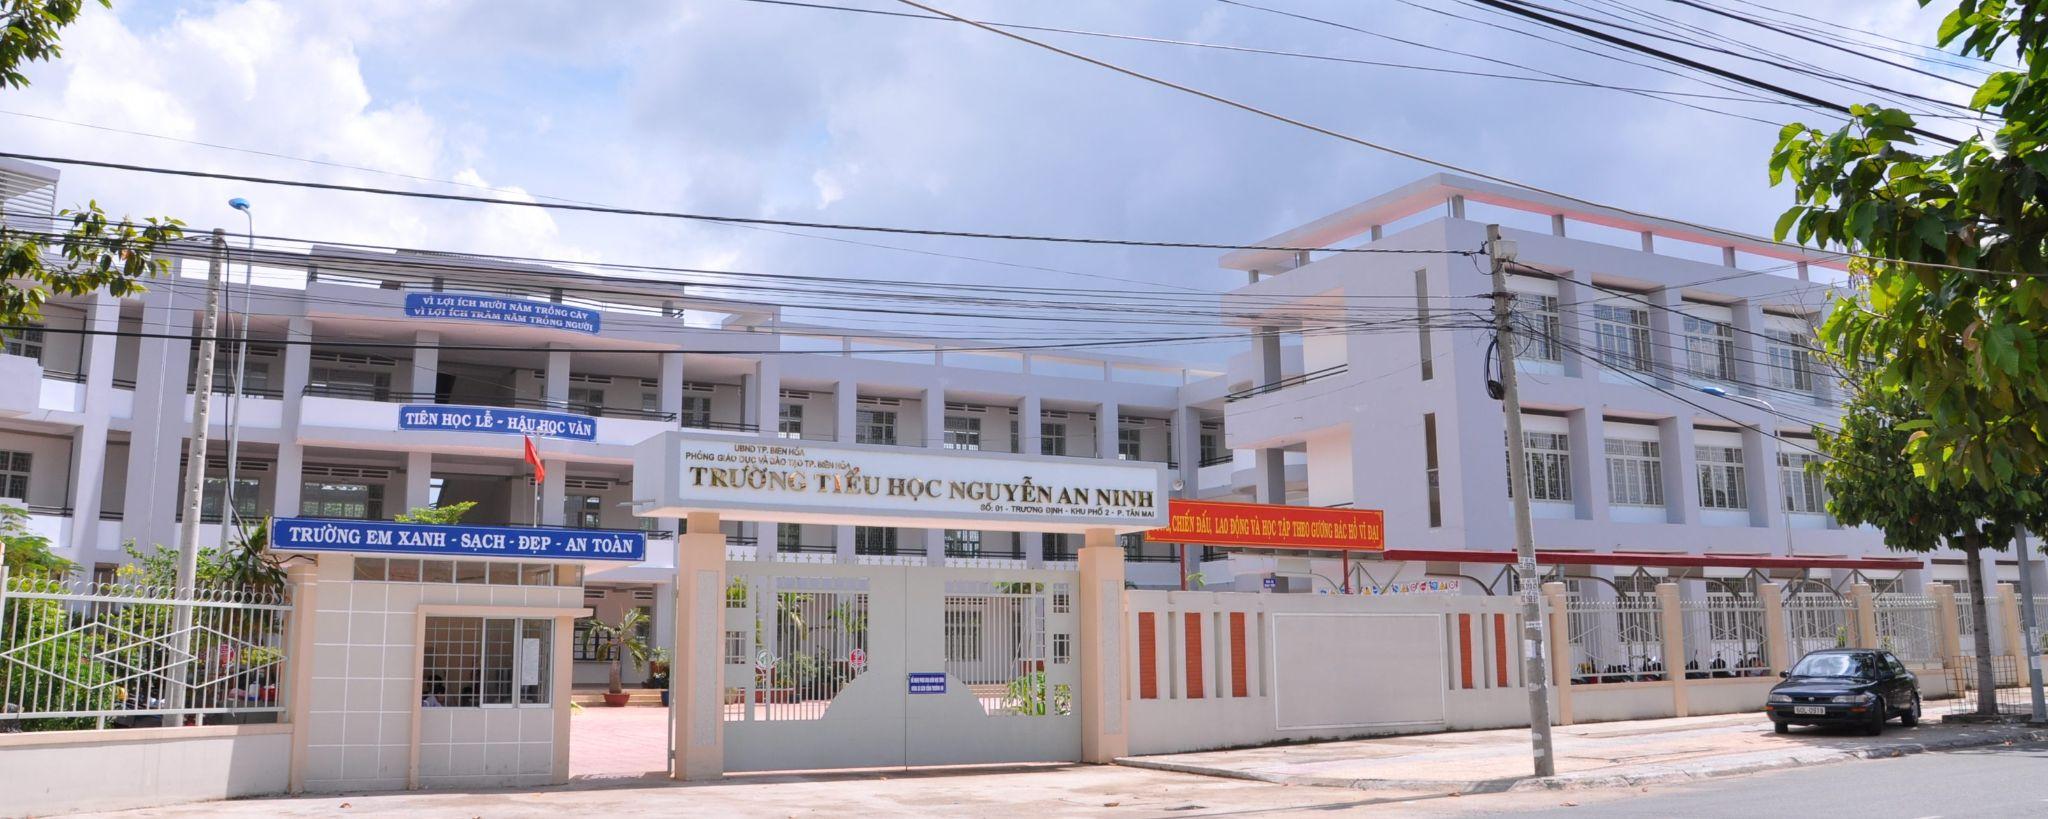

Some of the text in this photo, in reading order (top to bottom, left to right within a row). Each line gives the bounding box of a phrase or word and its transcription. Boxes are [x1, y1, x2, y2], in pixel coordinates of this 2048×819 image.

[422, 296, 434, 304] VÌ
[437, 298, 454, 306] LỢI
[458, 297, 476, 307] ÍCH
[479, 300, 507, 310] MƯỜI
[471, 310, 501, 320] TRĂM
[503, 313, 526, 322] NĂM
[405, 410, 438, 425] TIÊN
[441, 414, 471, 429] HỌC
[475, 410, 494, 428] LỄ
[508, 415, 536, 431] HẬU
[540, 420, 566, 433] HỌC
[568, 421, 592, 436] VĂN
[735, 444, 755, 452] UBND
[690, 465, 1154, 508] TRƯỜNG TIỂU HỌC NGUYỄN AN NINH
[1172, 508, 1194, 532] CHIẾN
[1215, 518, 1228, 534] LAO
[1230, 515, 1249, 538] ĐỘNG
[1250, 515, 1260, 535] VÀ
[1262, 520, 1276, 540] HỌC
[1278, 517, 1291, 540] TẬP
[1292, 521, 1310, 538] THEO
[1334, 520, 1348, 539] BÁC
[1348, 516, 1358, 540] HỒ
[1368, 525, 1379, 543] ĐẠI
[289, 524, 361, 544] TRƯỜNG
[366, 530, 393, 545] EM
[398, 531, 446, 546] XANH
[461, 533, 505, 551] SẠCH
[518, 535, 551, 554] ĐẸP
[565, 538, 587, 552] AN
[592, 535, 633, 553] TOÀN
